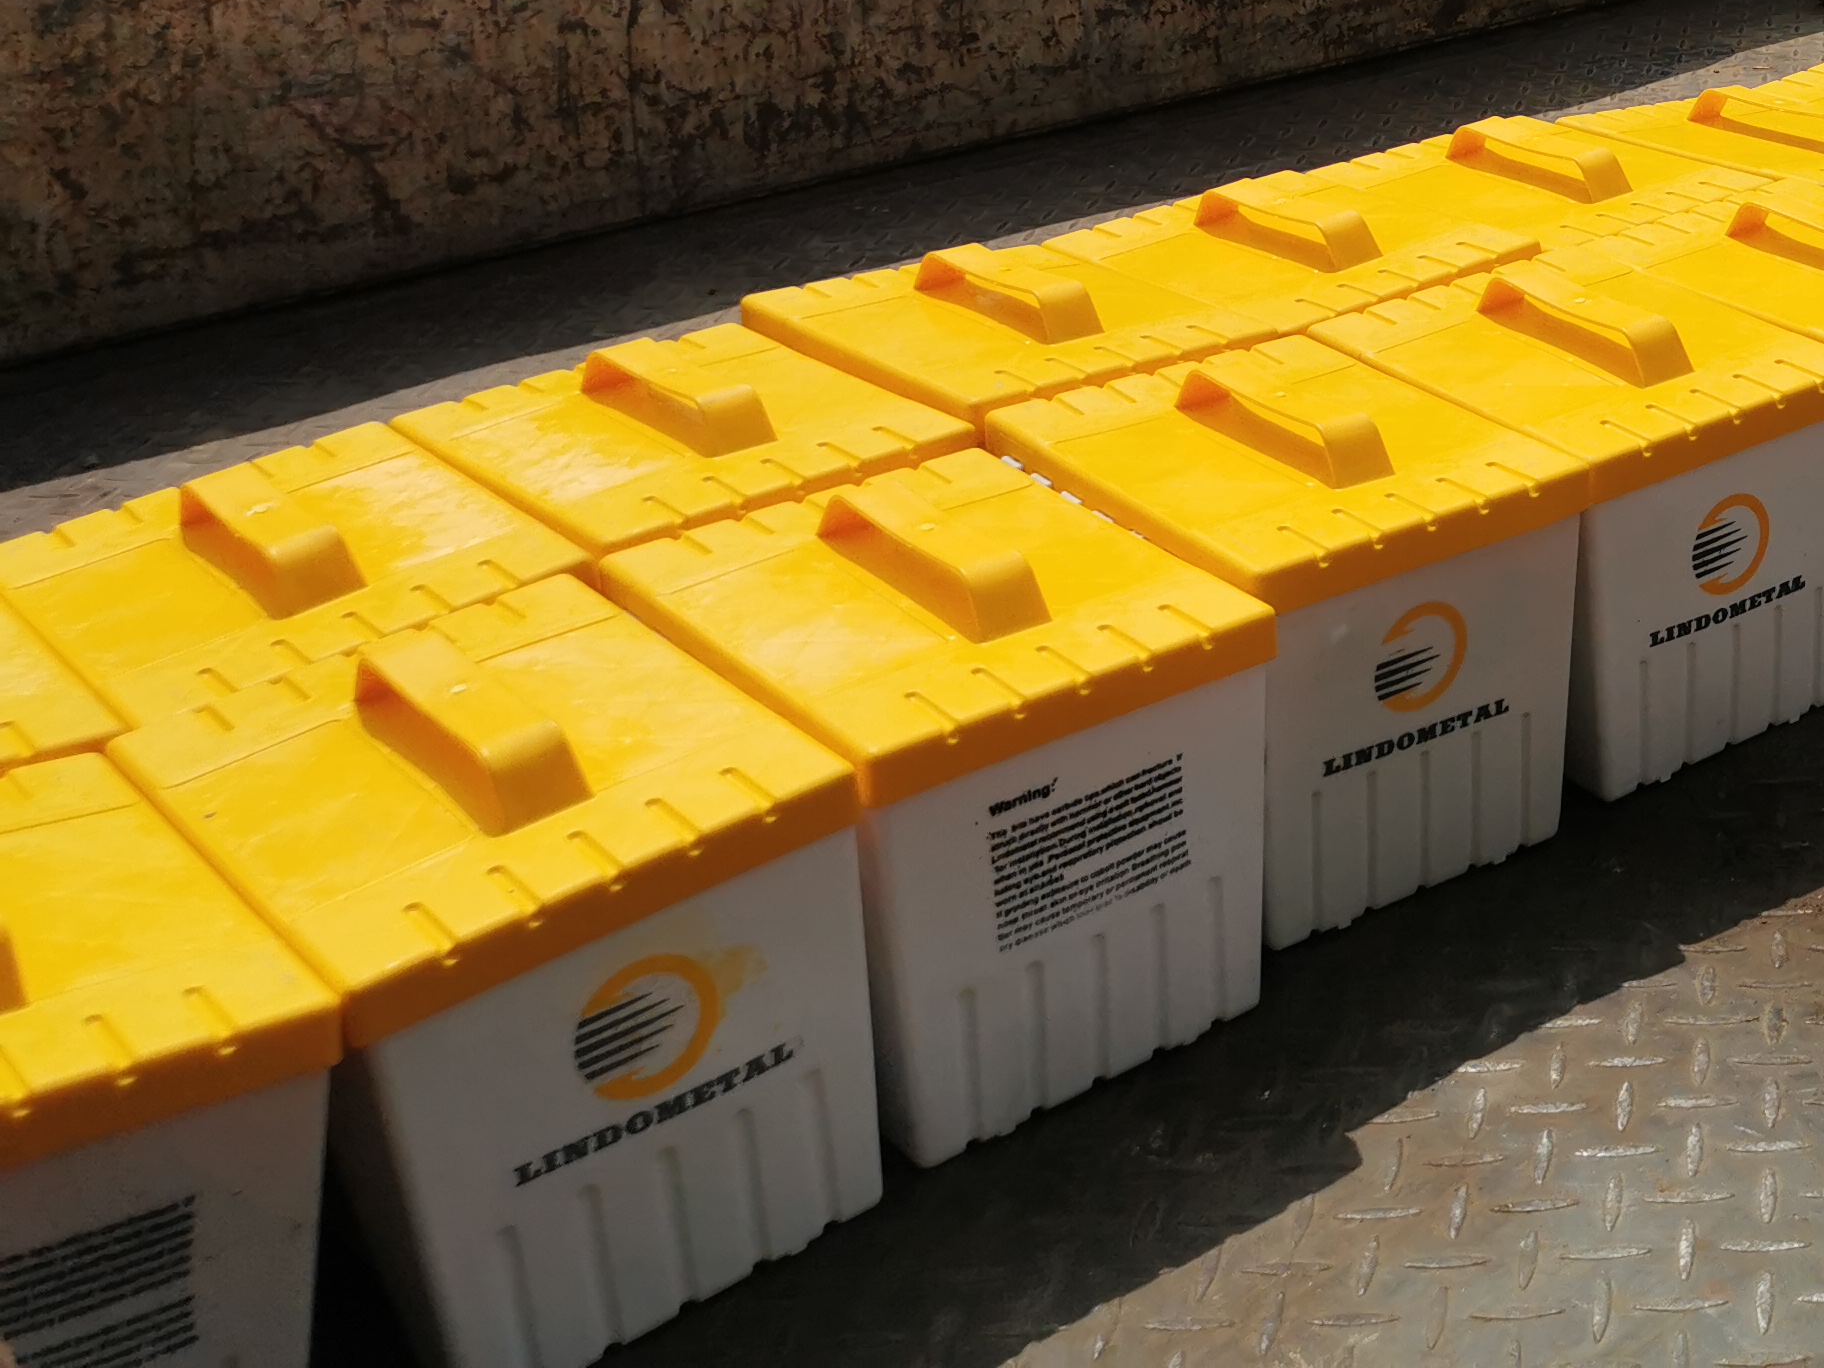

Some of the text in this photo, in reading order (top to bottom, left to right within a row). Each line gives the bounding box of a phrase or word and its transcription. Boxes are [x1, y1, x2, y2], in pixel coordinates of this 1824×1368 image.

[1649, 574, 1806, 647] LINDOMETAL
[1322, 698, 1510, 777] LINDOMETAL
[515, 1043, 794, 1187] LINDOMETAL
